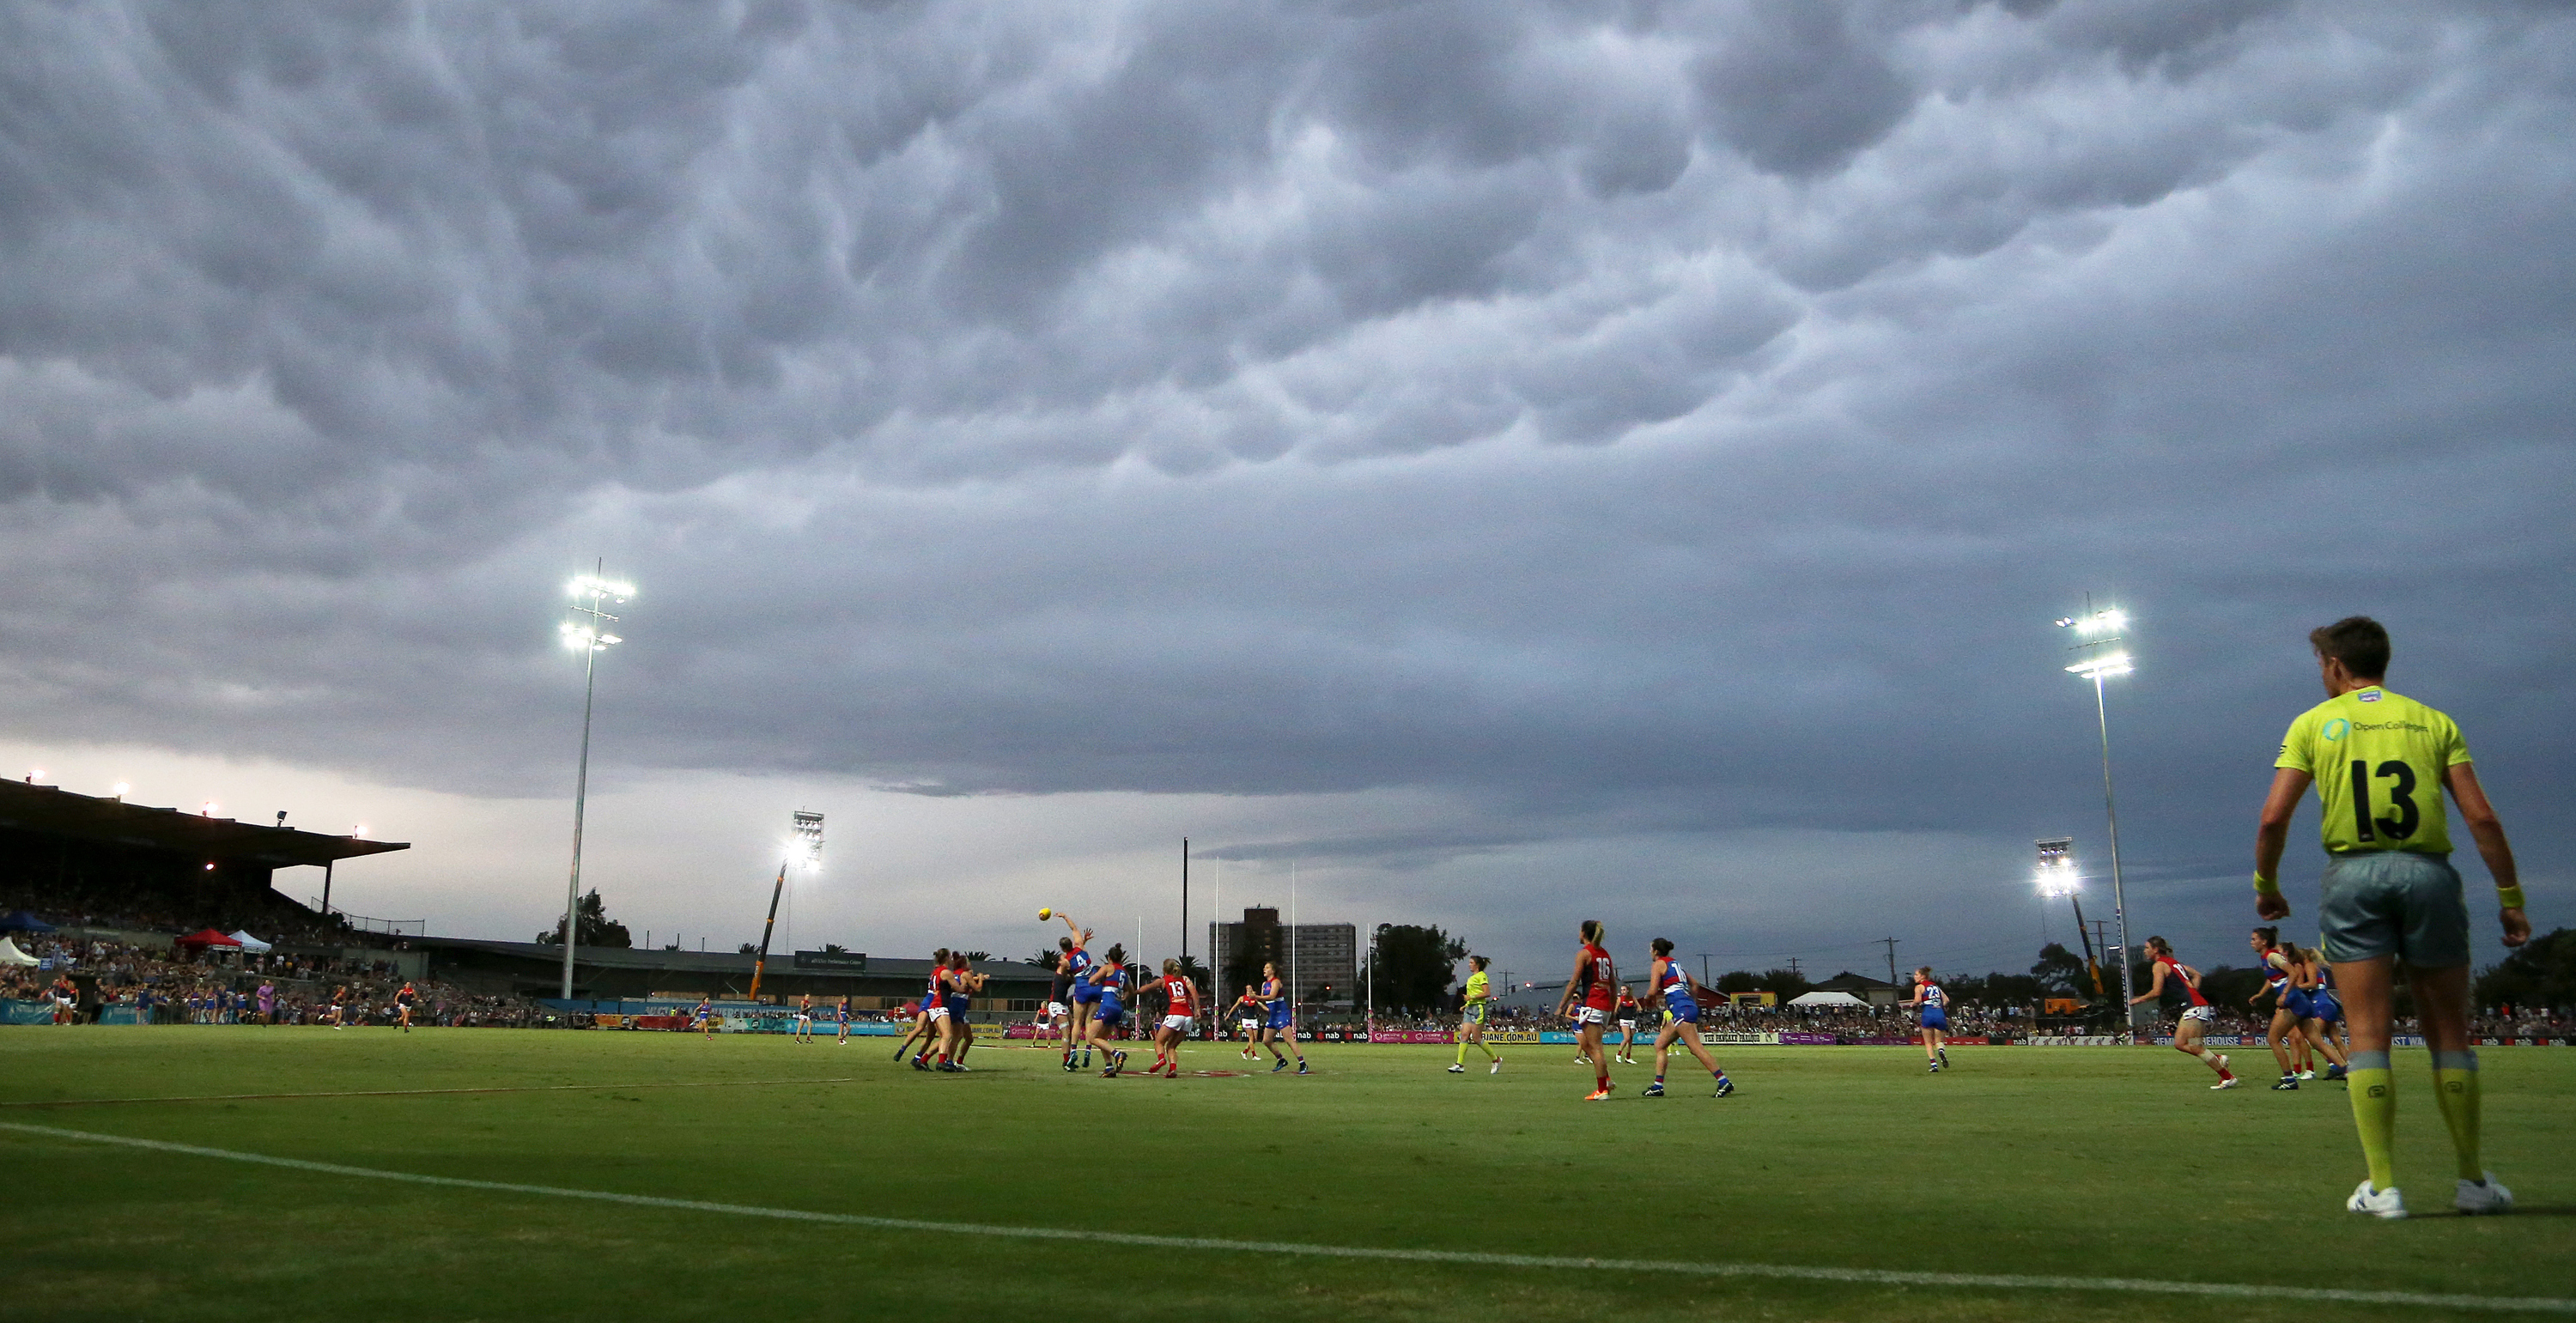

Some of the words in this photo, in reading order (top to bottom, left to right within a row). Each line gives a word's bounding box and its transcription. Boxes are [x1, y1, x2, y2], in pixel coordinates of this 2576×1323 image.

[2351, 760, 2421, 842] 13
[1076, 955, 1088, 968] 4
[1596, 957, 1611, 980] 16
[1118, 972, 1127, 989] 5
[1169, 981, 1185, 997] 13
[1927, 986, 1941, 999] 23
[1482, 1033, 1537, 1041] BJANE.COM.AU
[2202, 1036, 2239, 1046] REHOUSE
[2482, 1037, 2499, 1046] nab
[2514, 1037, 2532, 1046] nab
[2548, 1037, 2566, 1047] nab
